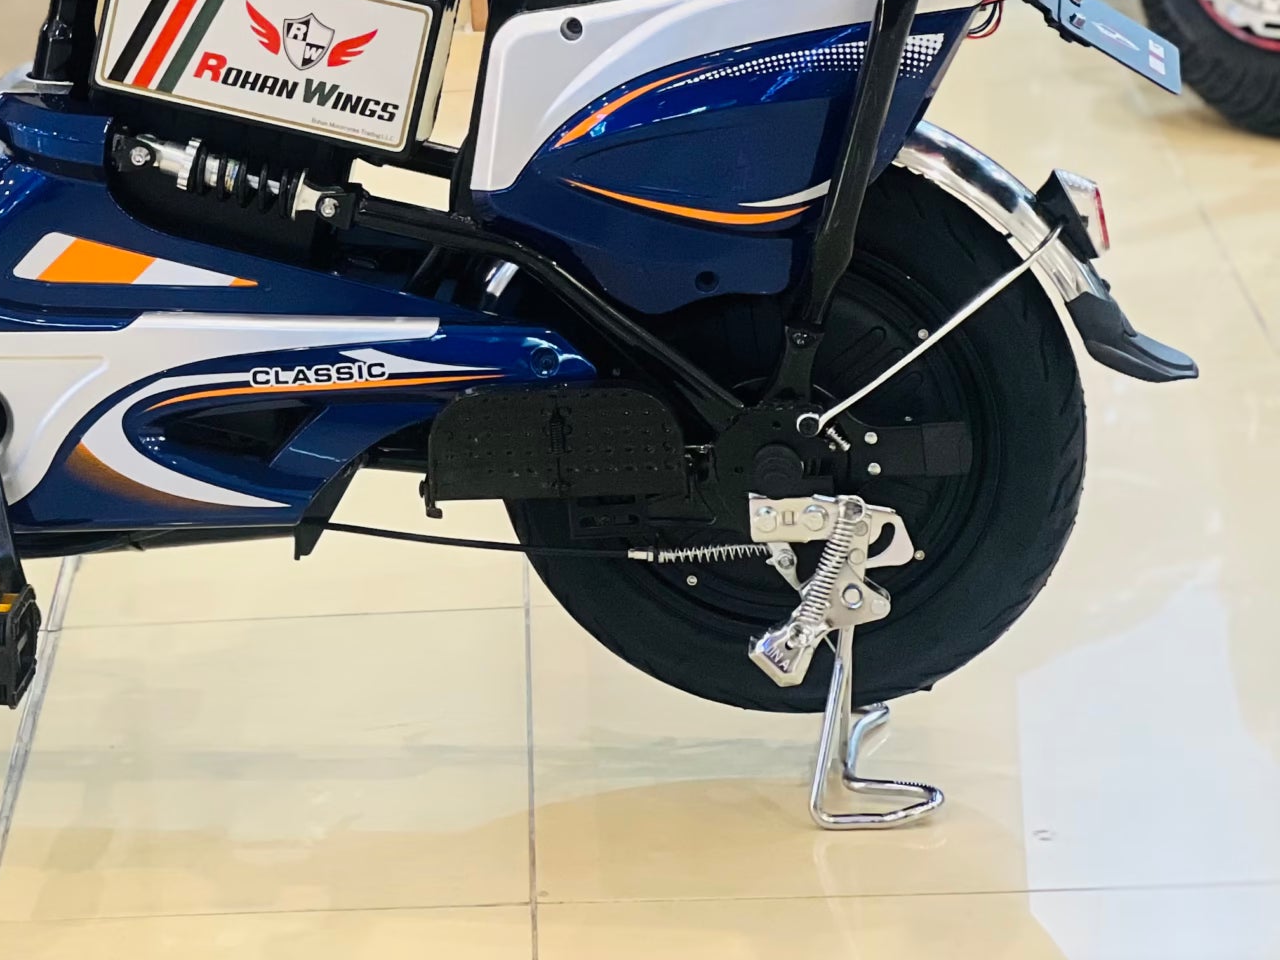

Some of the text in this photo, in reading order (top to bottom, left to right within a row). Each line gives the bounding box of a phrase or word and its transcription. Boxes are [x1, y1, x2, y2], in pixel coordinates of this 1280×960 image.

[287, 23, 308, 41] R
[304, 44, 323, 61] W
[193, 51, 399, 122] ROHAN WINGS
[251, 362, 387, 386] CLASSIC
